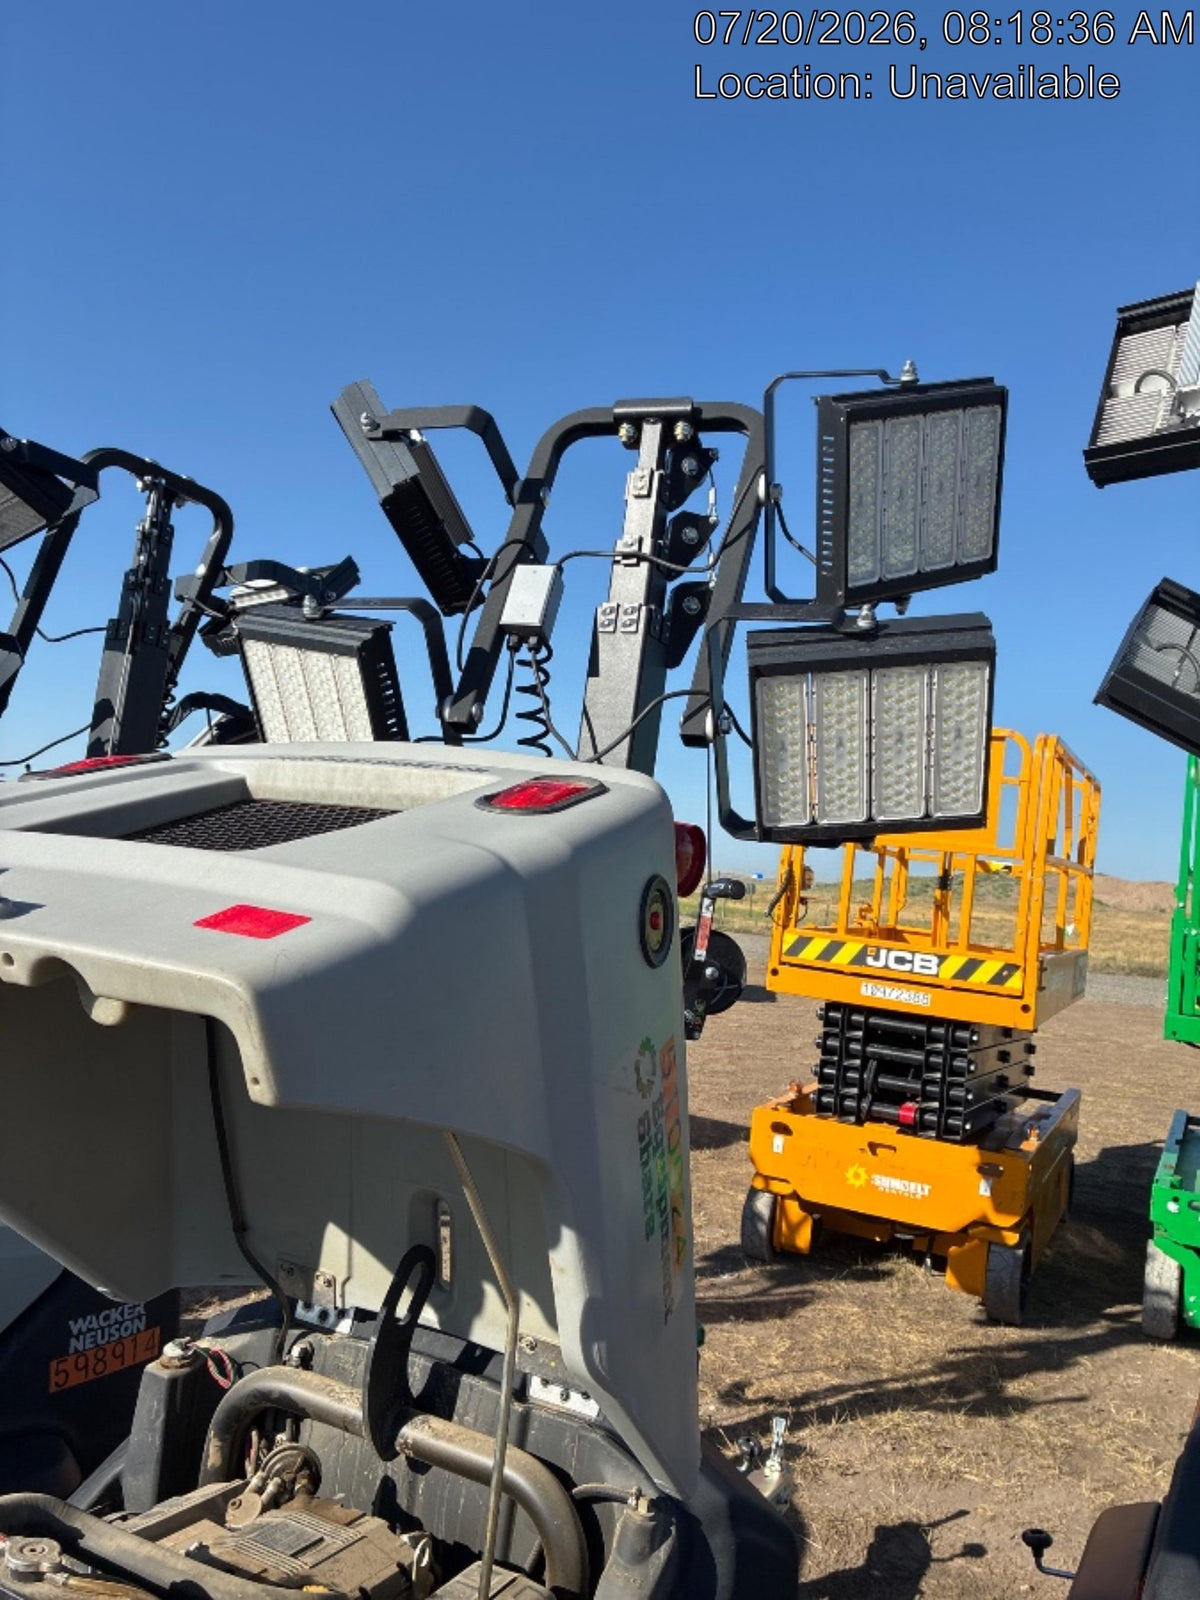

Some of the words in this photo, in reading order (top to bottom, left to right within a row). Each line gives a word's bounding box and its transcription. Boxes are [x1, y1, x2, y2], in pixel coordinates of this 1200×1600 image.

[866, 947, 939, 975] JCB
[68, 1303, 146, 1337] WACKER
[68, 1315, 147, 1354] NEUSON
[54, 1328, 157, 1388] 598914
